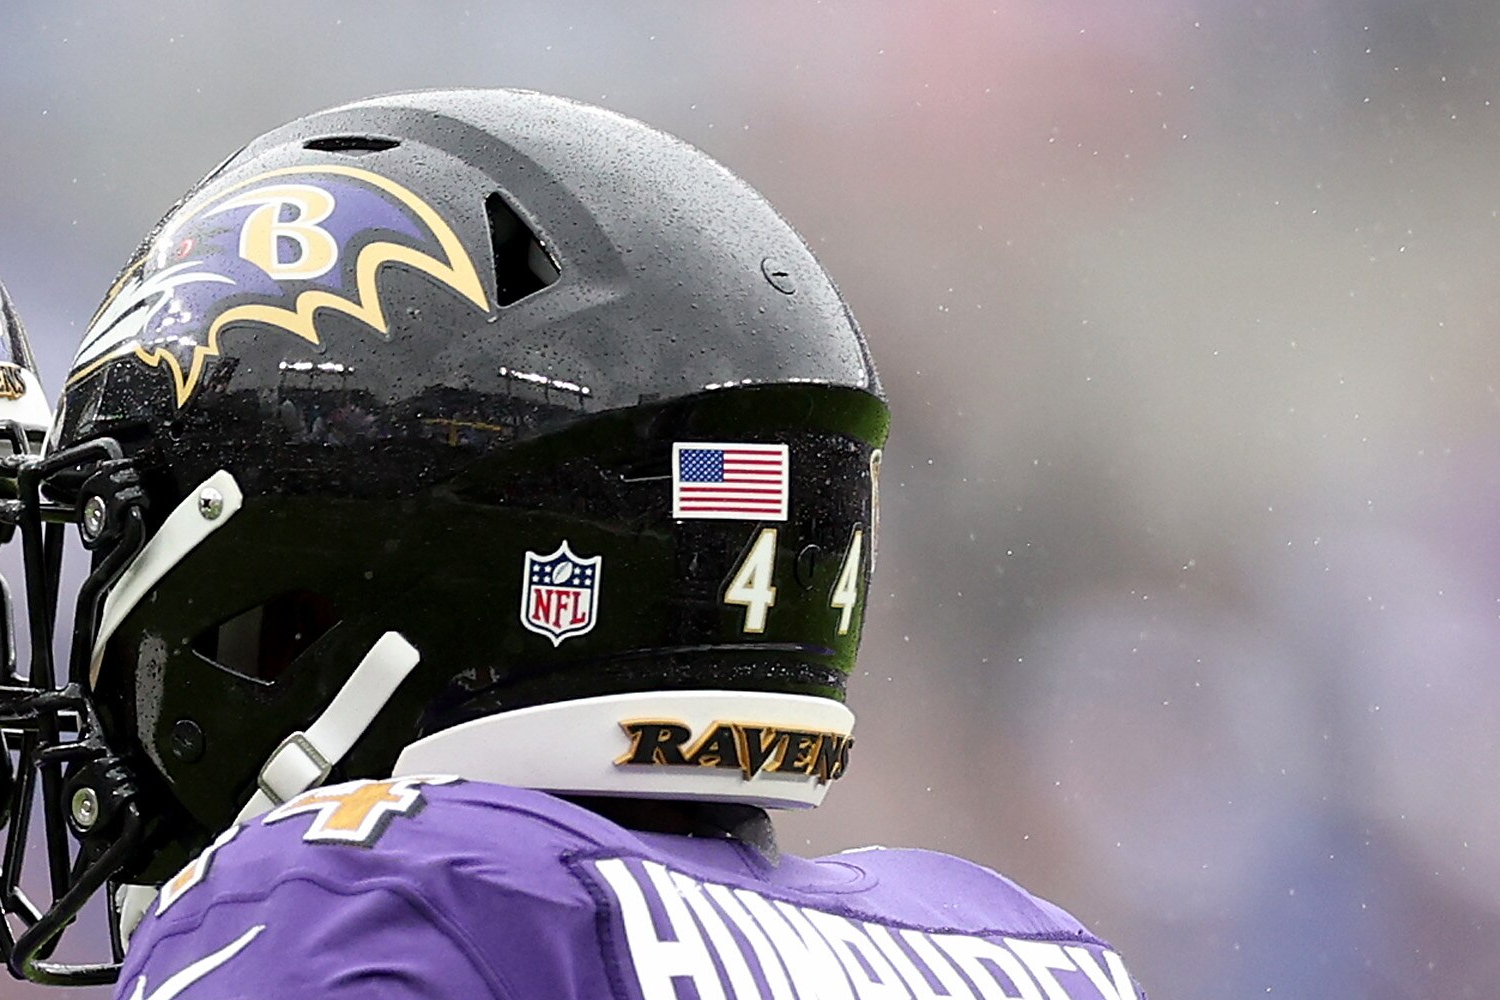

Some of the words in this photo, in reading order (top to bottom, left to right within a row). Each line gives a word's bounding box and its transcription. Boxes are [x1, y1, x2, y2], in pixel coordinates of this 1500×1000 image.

[200, 184, 339, 281] B
[531, 588, 587, 629] NFL
[612, 717, 855, 786] RAVENS
